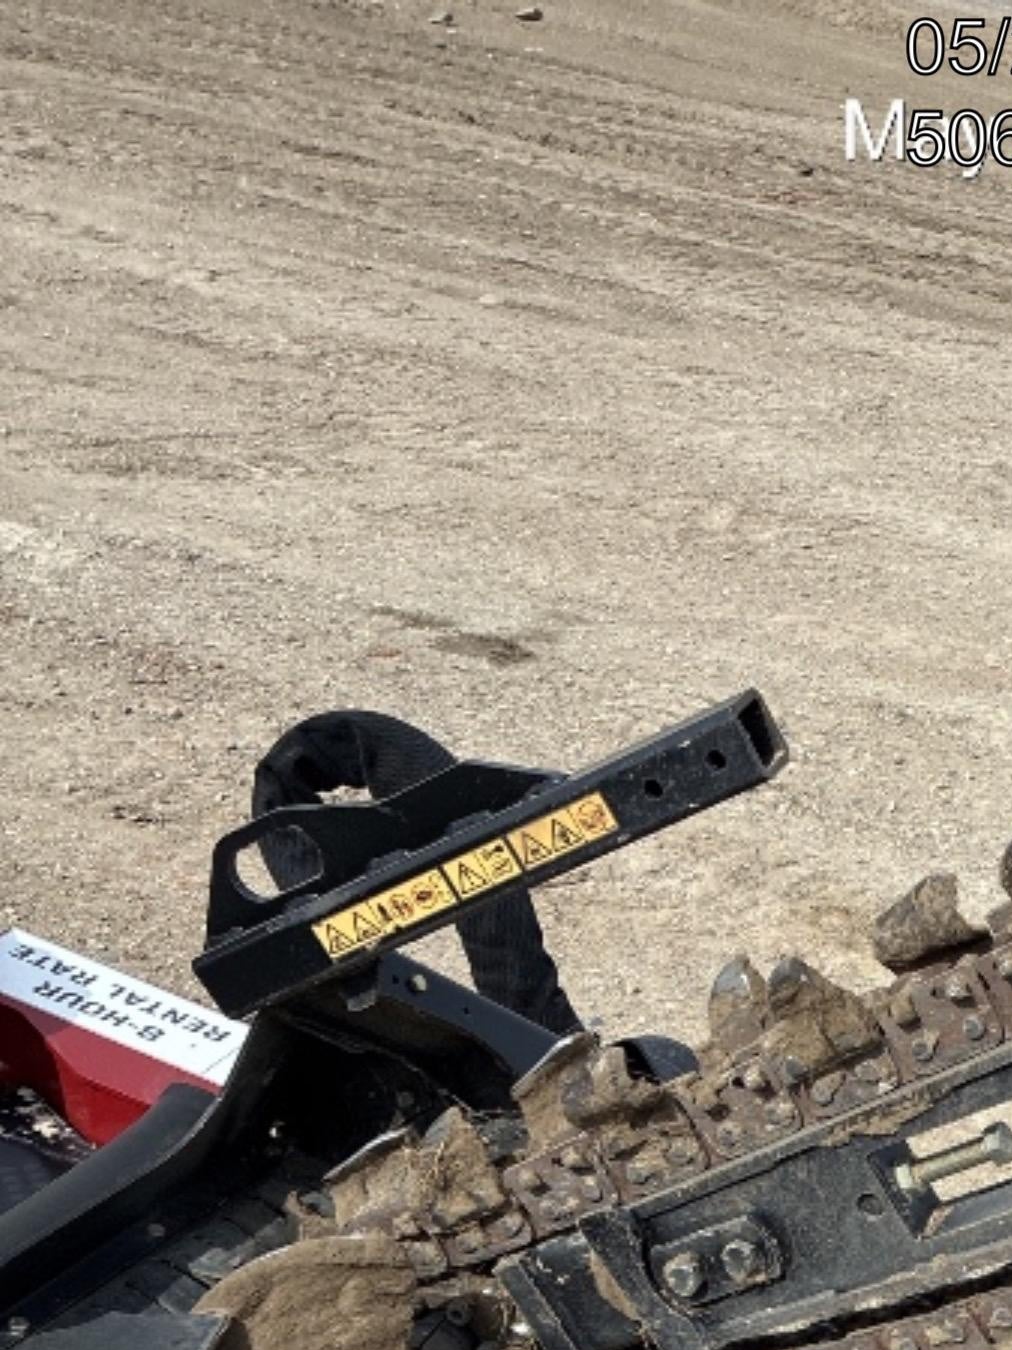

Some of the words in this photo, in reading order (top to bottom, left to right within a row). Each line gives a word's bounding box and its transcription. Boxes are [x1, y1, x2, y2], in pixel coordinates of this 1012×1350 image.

[8, 944, 99, 987] RATE
[33, 980, 165, 1042] 8-HOUR
[108, 983, 232, 1043] RENTAL
